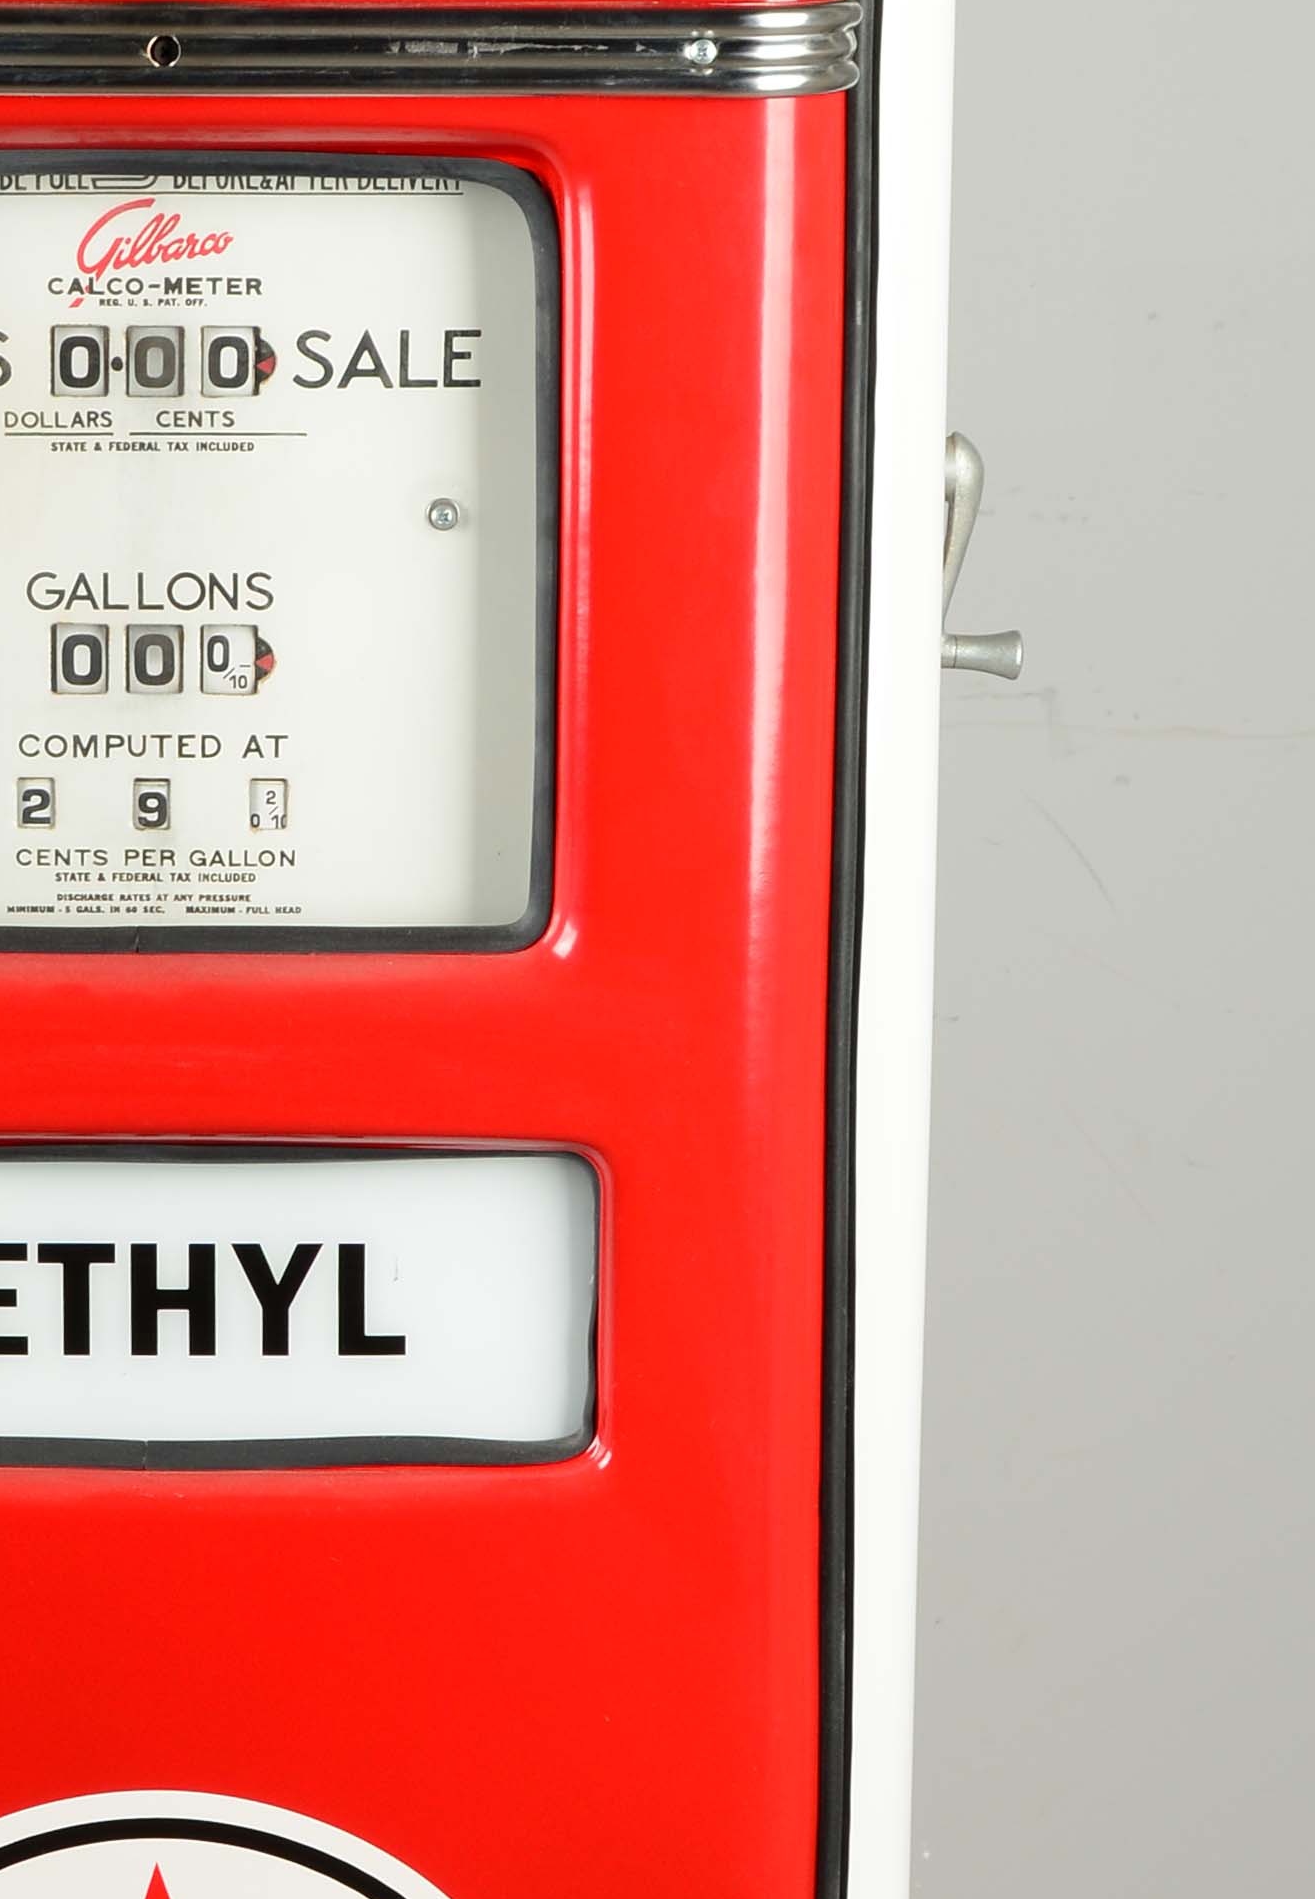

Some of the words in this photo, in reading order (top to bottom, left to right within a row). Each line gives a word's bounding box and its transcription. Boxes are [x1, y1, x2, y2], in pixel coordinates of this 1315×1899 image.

[72, 198, 234, 301] Gilbarco
[47, 277, 262, 296] CALCO-METER
[99, 298, 122, 307] REG.
[158, 298, 180, 307] PAT.
[185, 298, 207, 307] OFF.
[293, 328, 482, 389] SALE
[4, 410, 113, 428] DOLLARS
[156, 410, 235, 428] CENTS
[51, 441, 86, 452] STATE
[94, 441, 102, 452] &
[109, 441, 160, 452] FEDERAL
[167, 441, 188, 452] TAX
[196, 441, 255, 452] INCLUDED
[26, 572, 275, 612] GALLONS
[19, 734, 222, 759] COMPUTED
[242, 734, 289, 759] AT
[21, 788, 52, 824] 2
[138, 791, 167, 827] 9
[16, 849, 108, 867] CENTS
[124, 849, 175, 867] PER
[189, 849, 296, 867] GALLON
[55, 872, 90, 883] STATE
[98, 872, 105, 883] &
[112, 872, 163, 883] FEDERAL
[170, 872, 191, 883] TAX
[198, 872, 256, 883] INCLUDED
[57, 893, 114, 902] DISCHARGE
[119, 893, 151, 902] RATES
[156, 893, 169, 902] AT
[173, 893, 193, 902] ANY
[199, 893, 251, 902] PRESSURE
[7, 905, 55, 914] MINIMUM
[186, 905, 235, 914] MAXIMUM
[246, 905, 270, 914] FULL
[276, 905, 302, 914] HEAD
